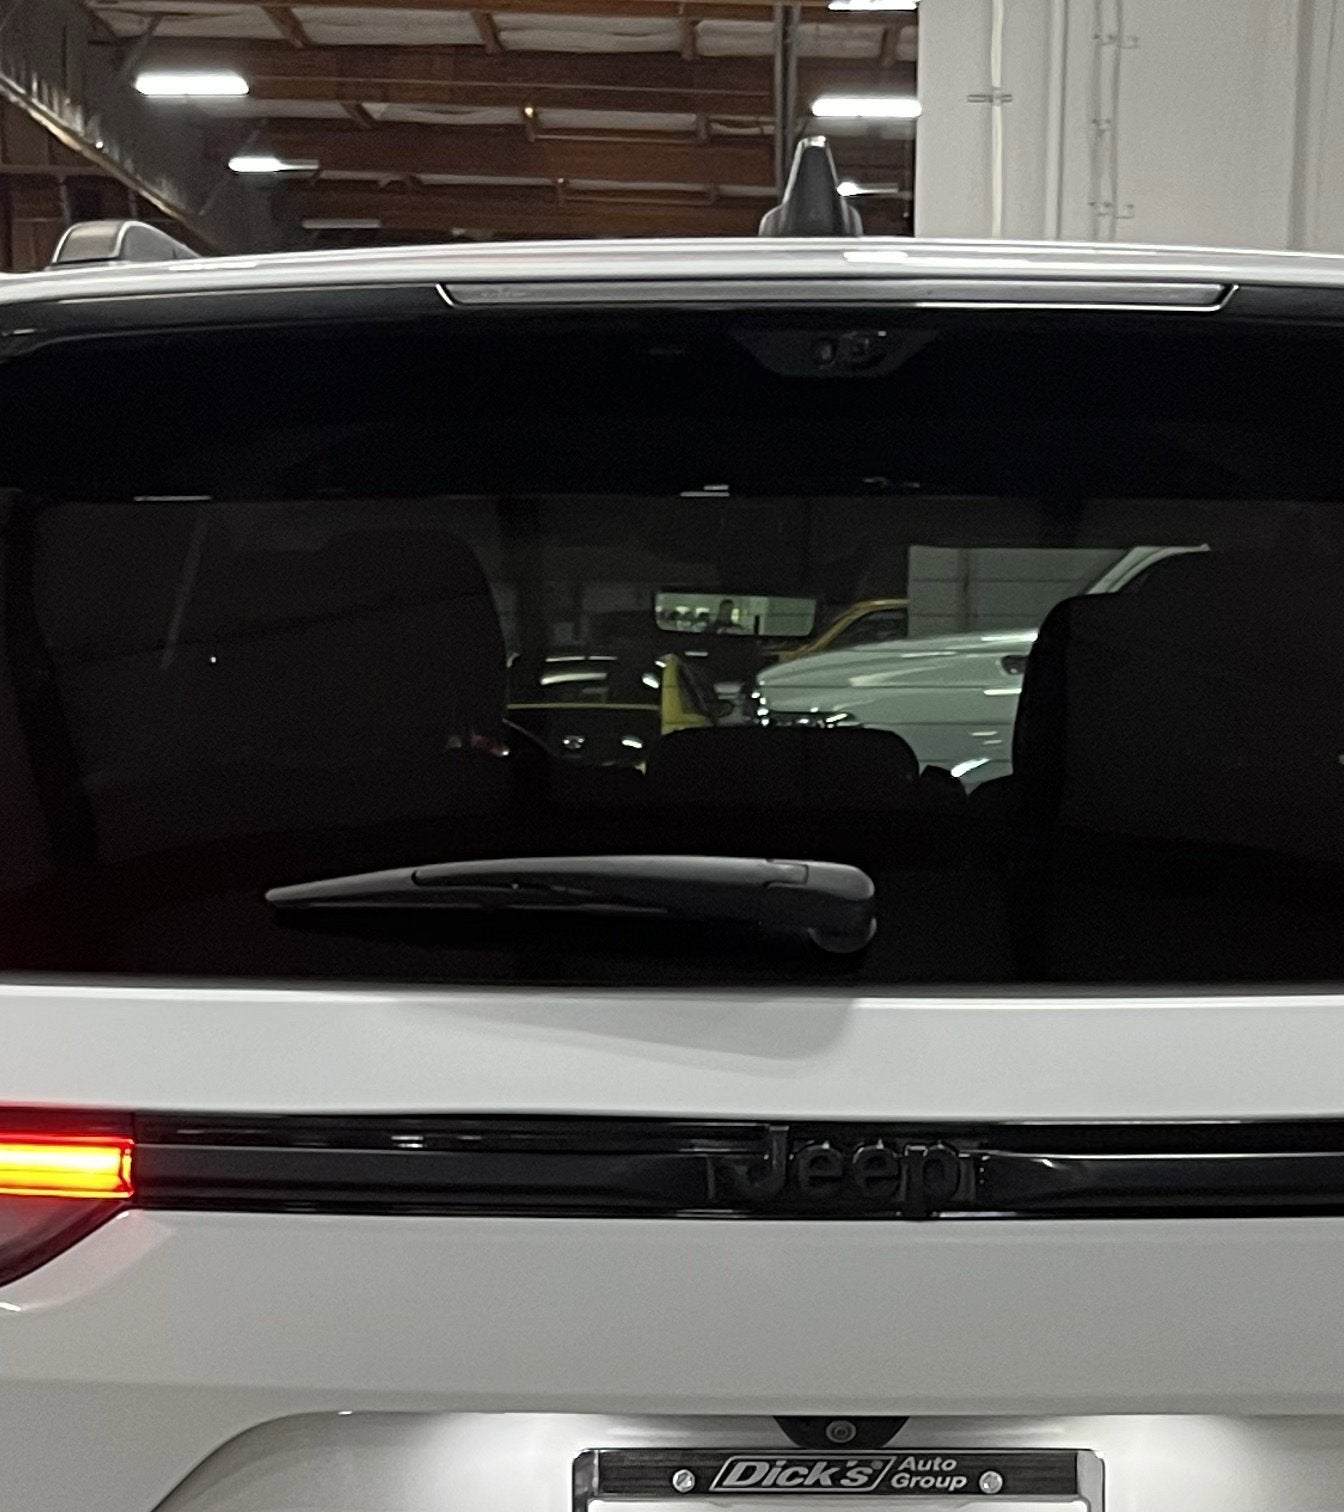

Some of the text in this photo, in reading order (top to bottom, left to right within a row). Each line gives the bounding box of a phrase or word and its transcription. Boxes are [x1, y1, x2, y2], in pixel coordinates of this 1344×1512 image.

[733, 1125, 962, 1218] Jeep
[721, 1456, 957, 1488] Dick's Auto
[890, 1473, 967, 1492] Group
